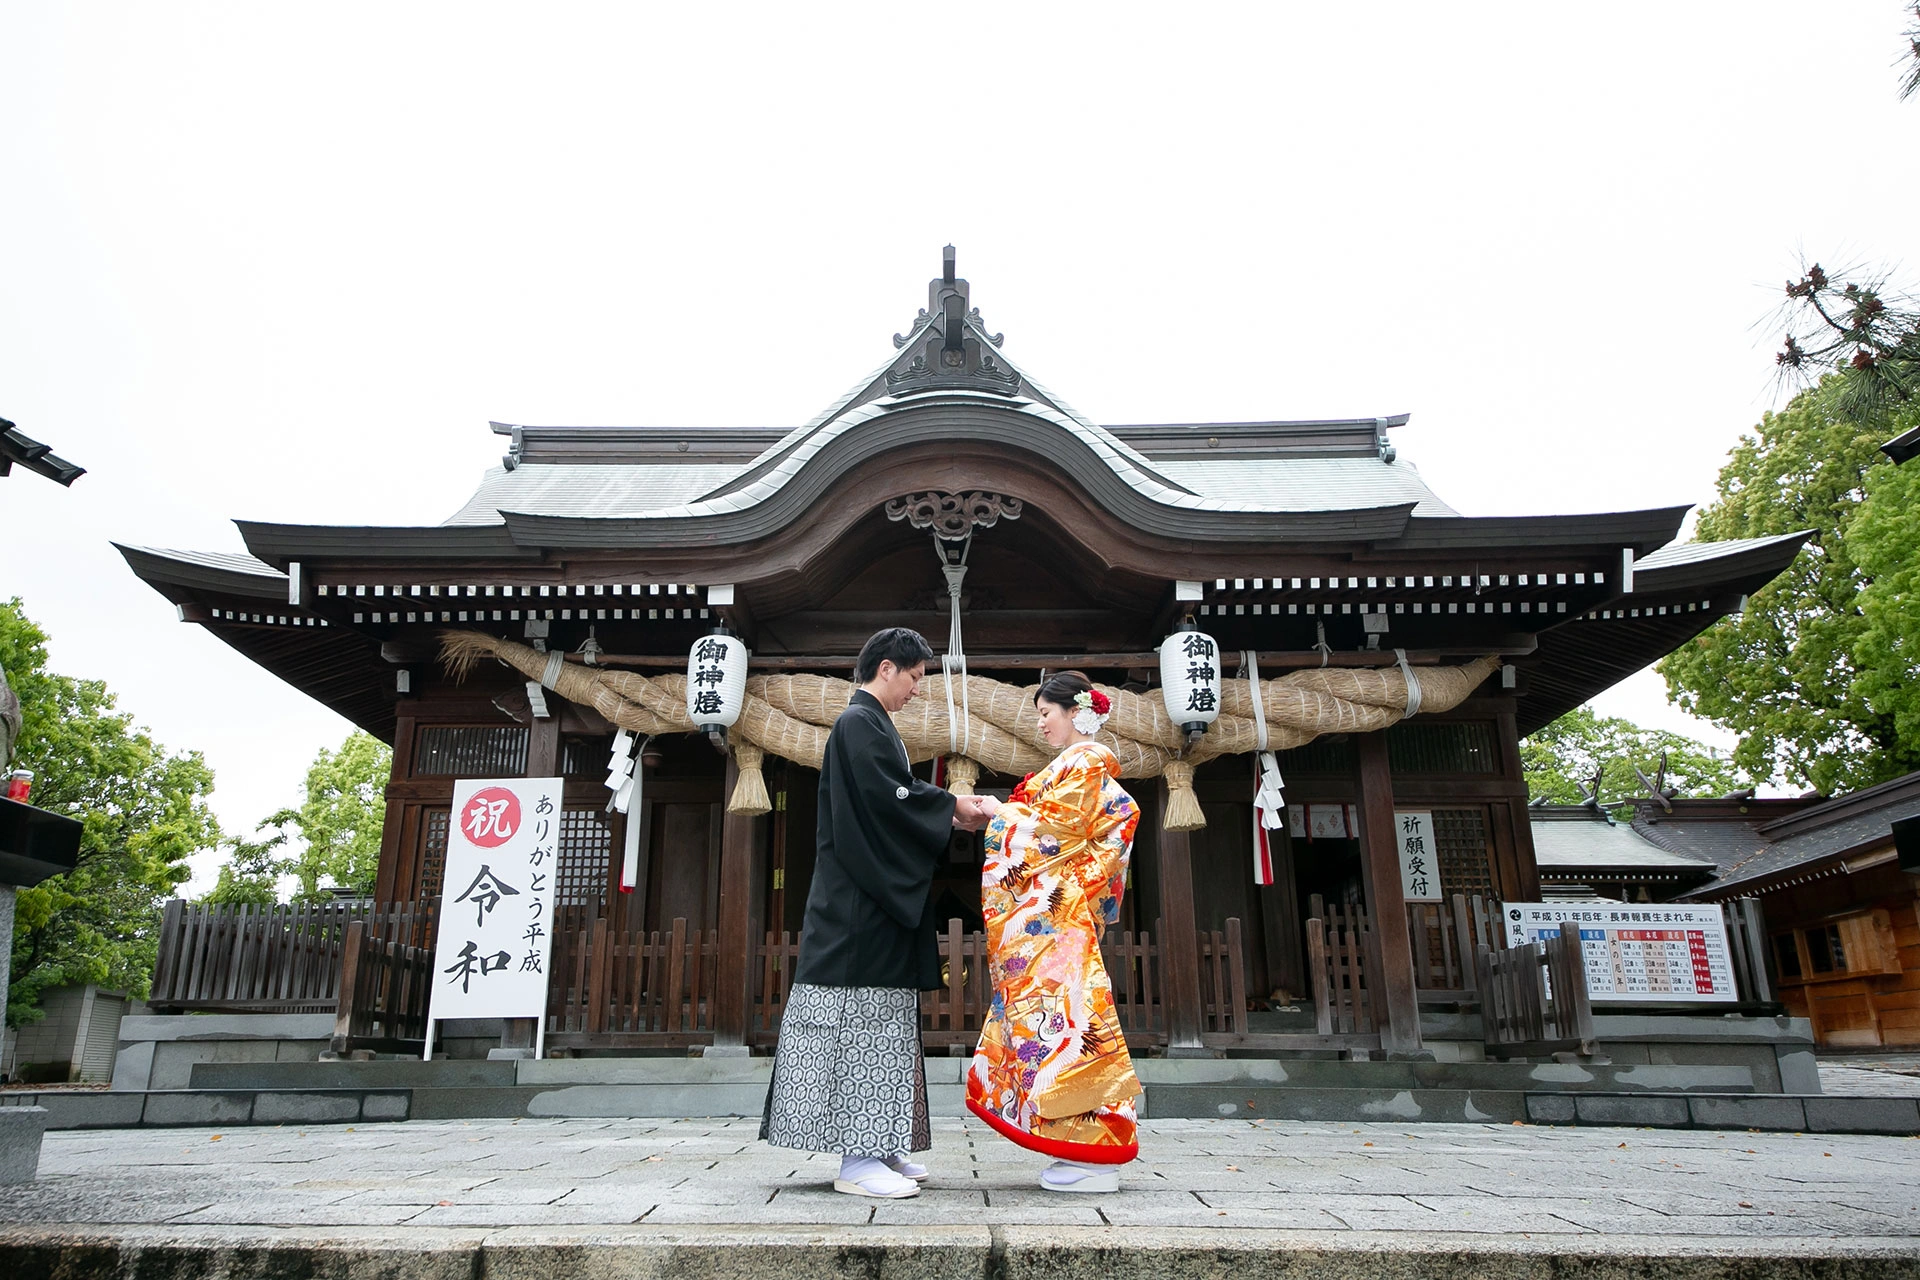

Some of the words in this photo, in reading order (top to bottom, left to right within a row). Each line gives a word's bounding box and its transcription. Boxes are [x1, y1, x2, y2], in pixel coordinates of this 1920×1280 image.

[693, 638, 729, 715] 御神燈
[1182, 634, 1217, 712] 御神燈
[466, 798, 512, 839] 祝
[1402, 816, 1430, 897] 祈願受付
[519, 794, 554, 974] ありがとう平成
[444, 864, 521, 994] 令和
